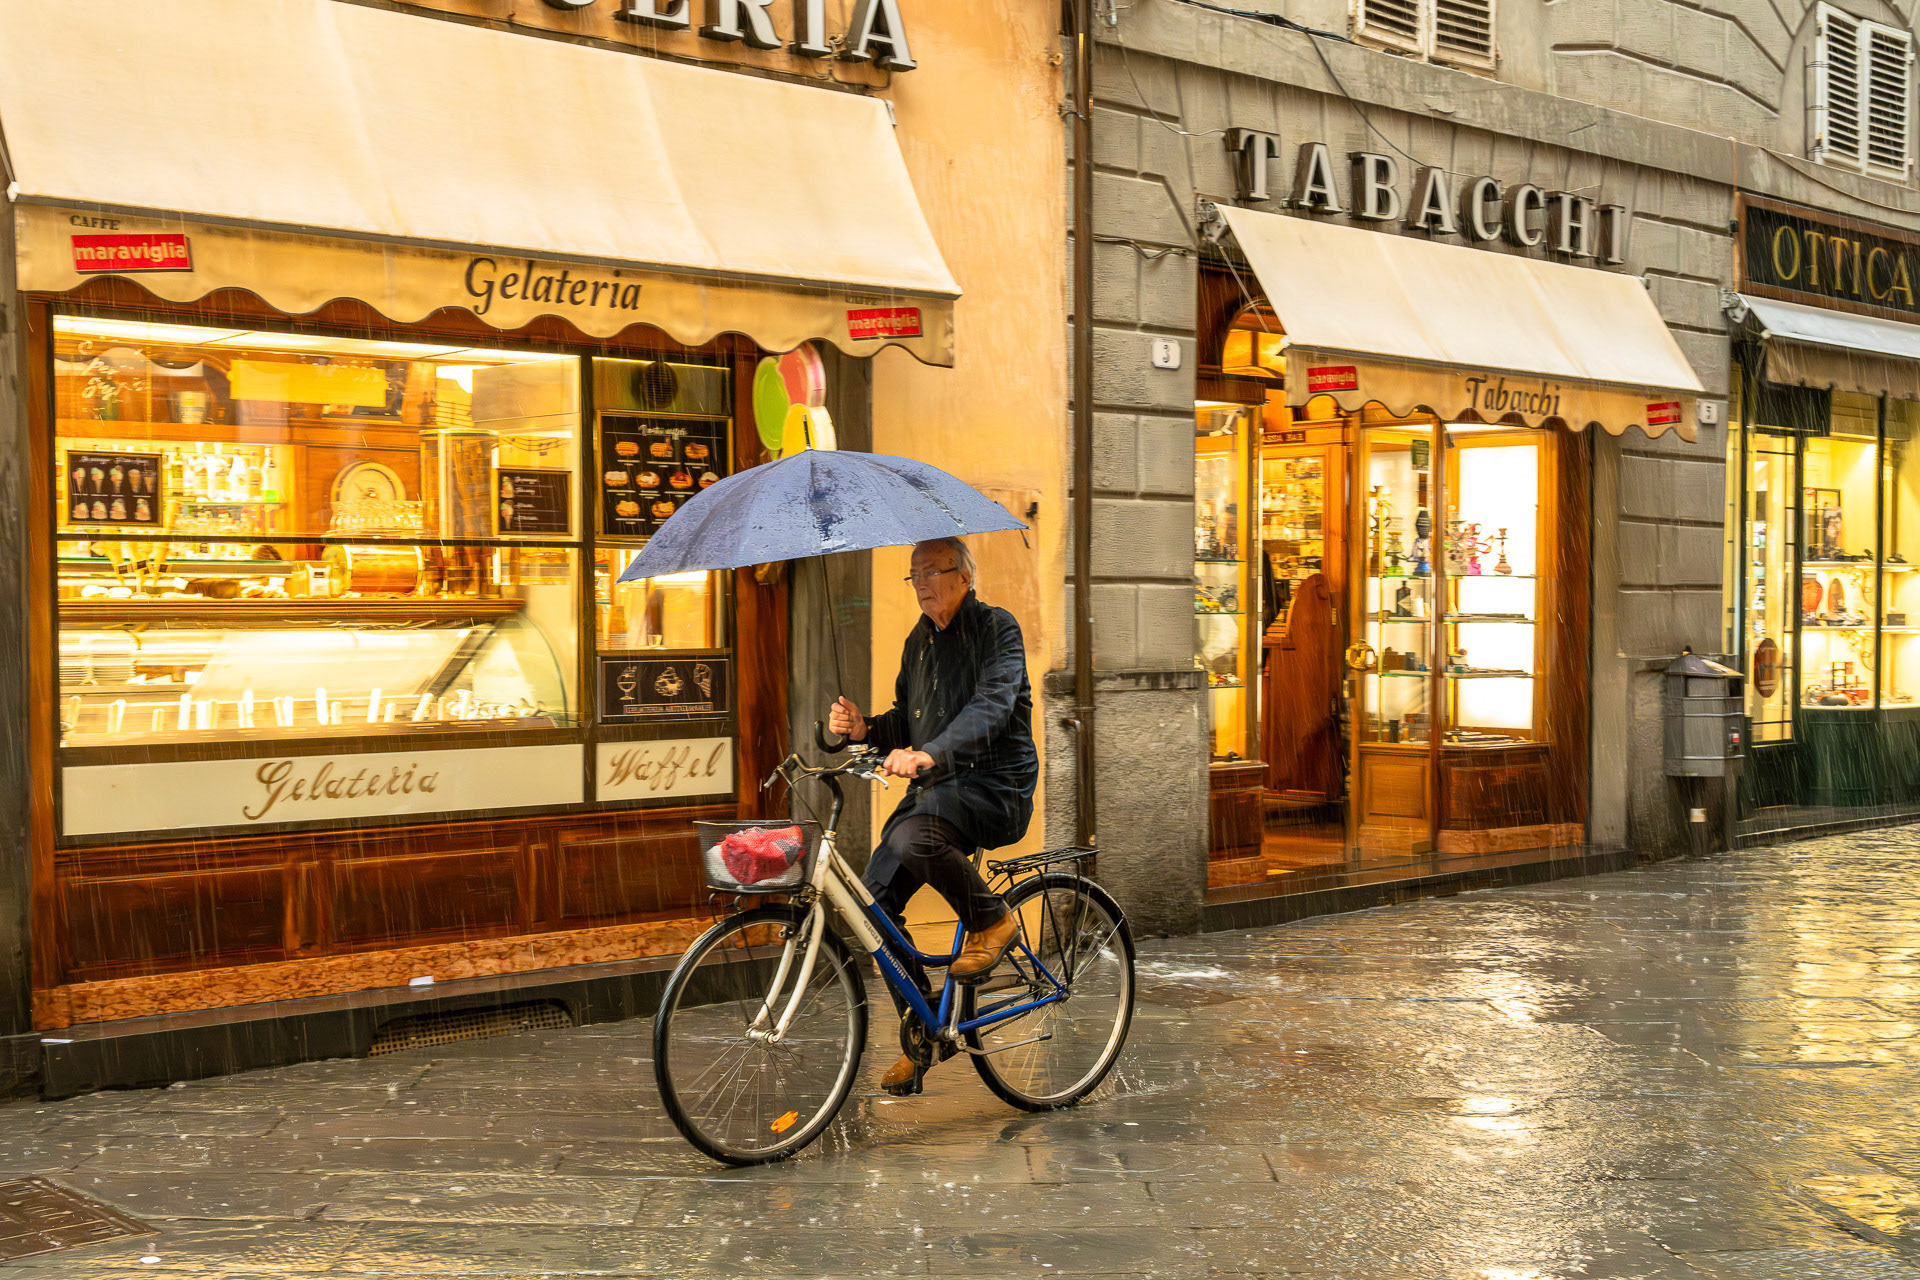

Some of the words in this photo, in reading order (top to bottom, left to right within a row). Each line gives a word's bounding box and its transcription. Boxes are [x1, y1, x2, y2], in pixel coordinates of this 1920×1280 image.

[1226, 127, 1628, 265] TABACCHI
[74, 242, 187, 262] maraviglia
[1772, 225, 1915, 306] OTTICA
[465, 257, 642, 315] Gelateria
[1162, 344, 1171, 363] 3
[1465, 375, 1560, 416] Tabacchi
[242, 760, 440, 821] Gelateria
[604, 742, 726, 791] Waffel
